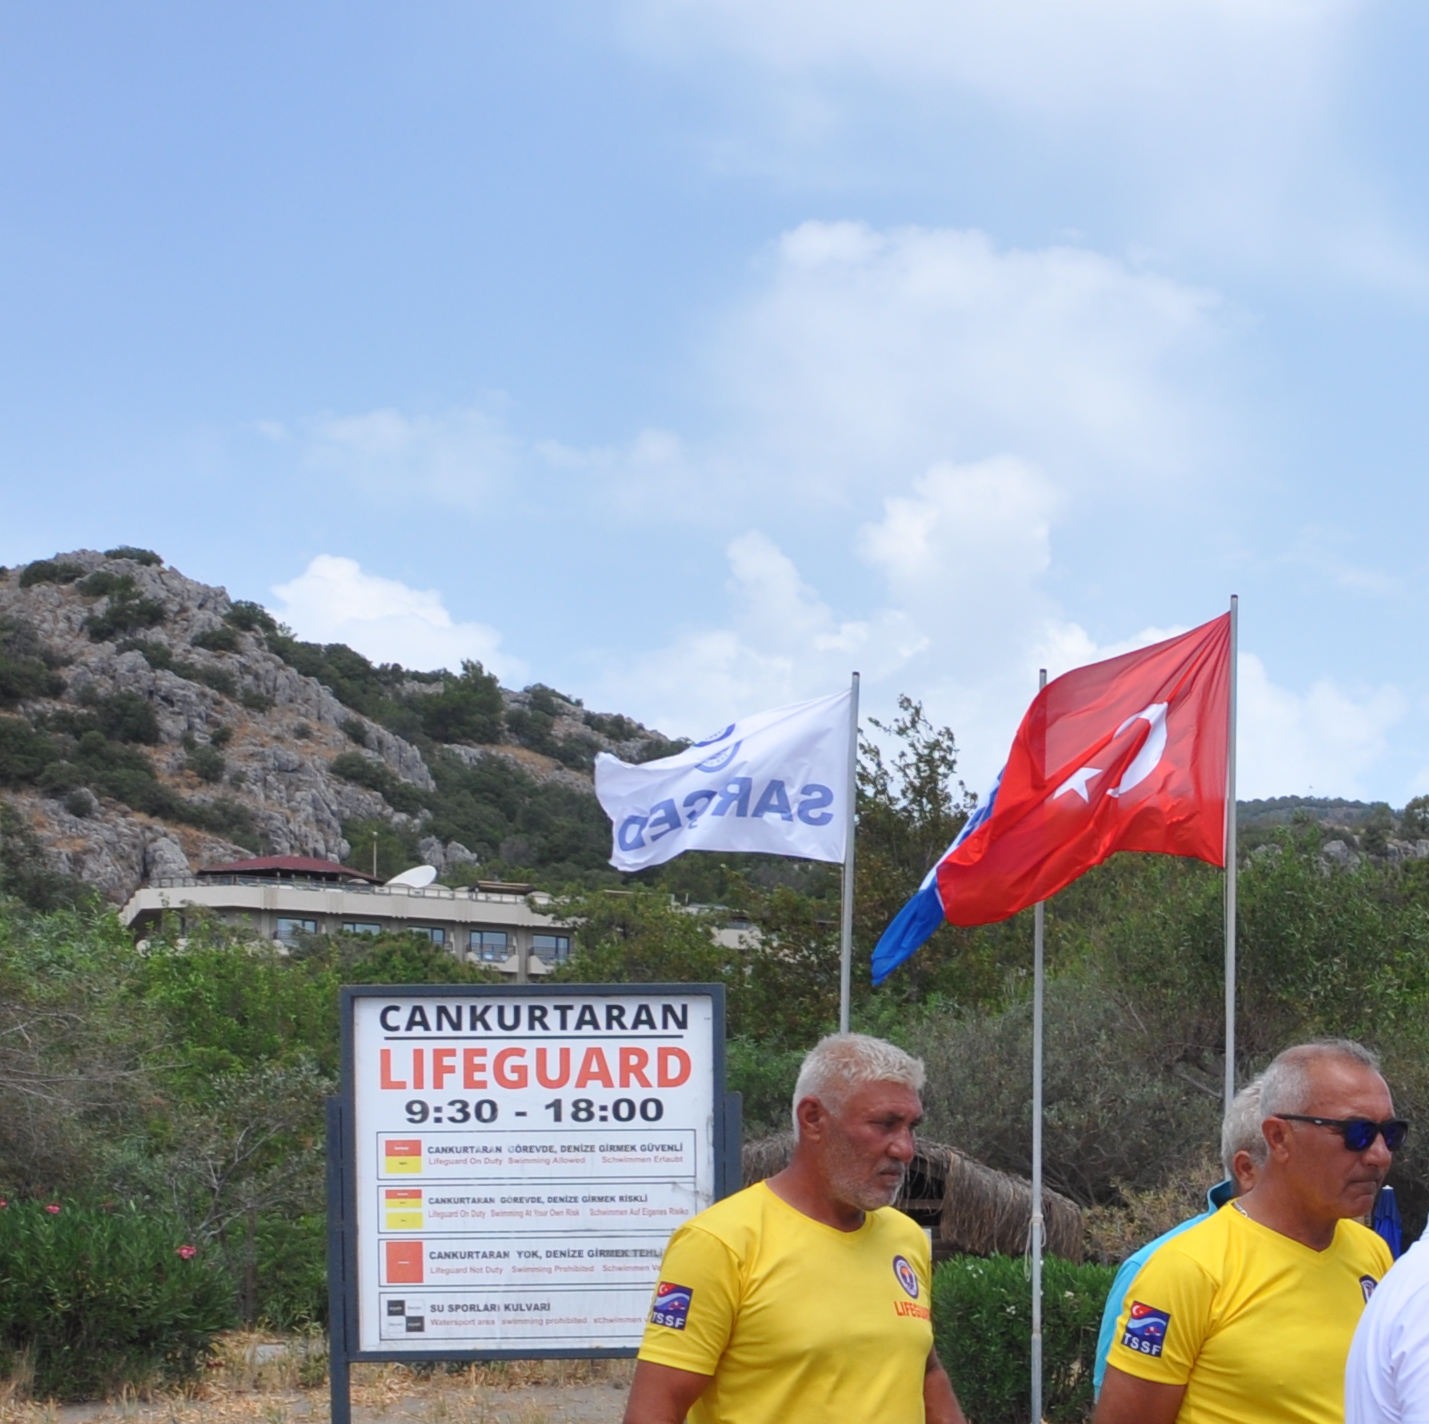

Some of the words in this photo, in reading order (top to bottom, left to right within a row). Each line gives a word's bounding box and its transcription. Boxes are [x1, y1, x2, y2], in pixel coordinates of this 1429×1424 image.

[379, 1004, 689, 1032] CANKURTARAN
[379, 1046, 692, 1090] LIFEGUARD
[404, 1098, 499, 1124] 9:30
[544, 1097, 664, 1123] 18:00
[427, 1146, 502, 1154] CANKURTARAN
[560, 1144, 595, 1153] DENİZE
[599, 1143, 637, 1152] GİRMEK
[429, 1250, 510, 1260] CANKURTARAN
[545, 1248, 584, 1258] DENİZE
[430, 1304, 445, 1313] SU
[651, 1311, 685, 1328] TSSF
[1123, 1332, 1162, 1356] TSSF
